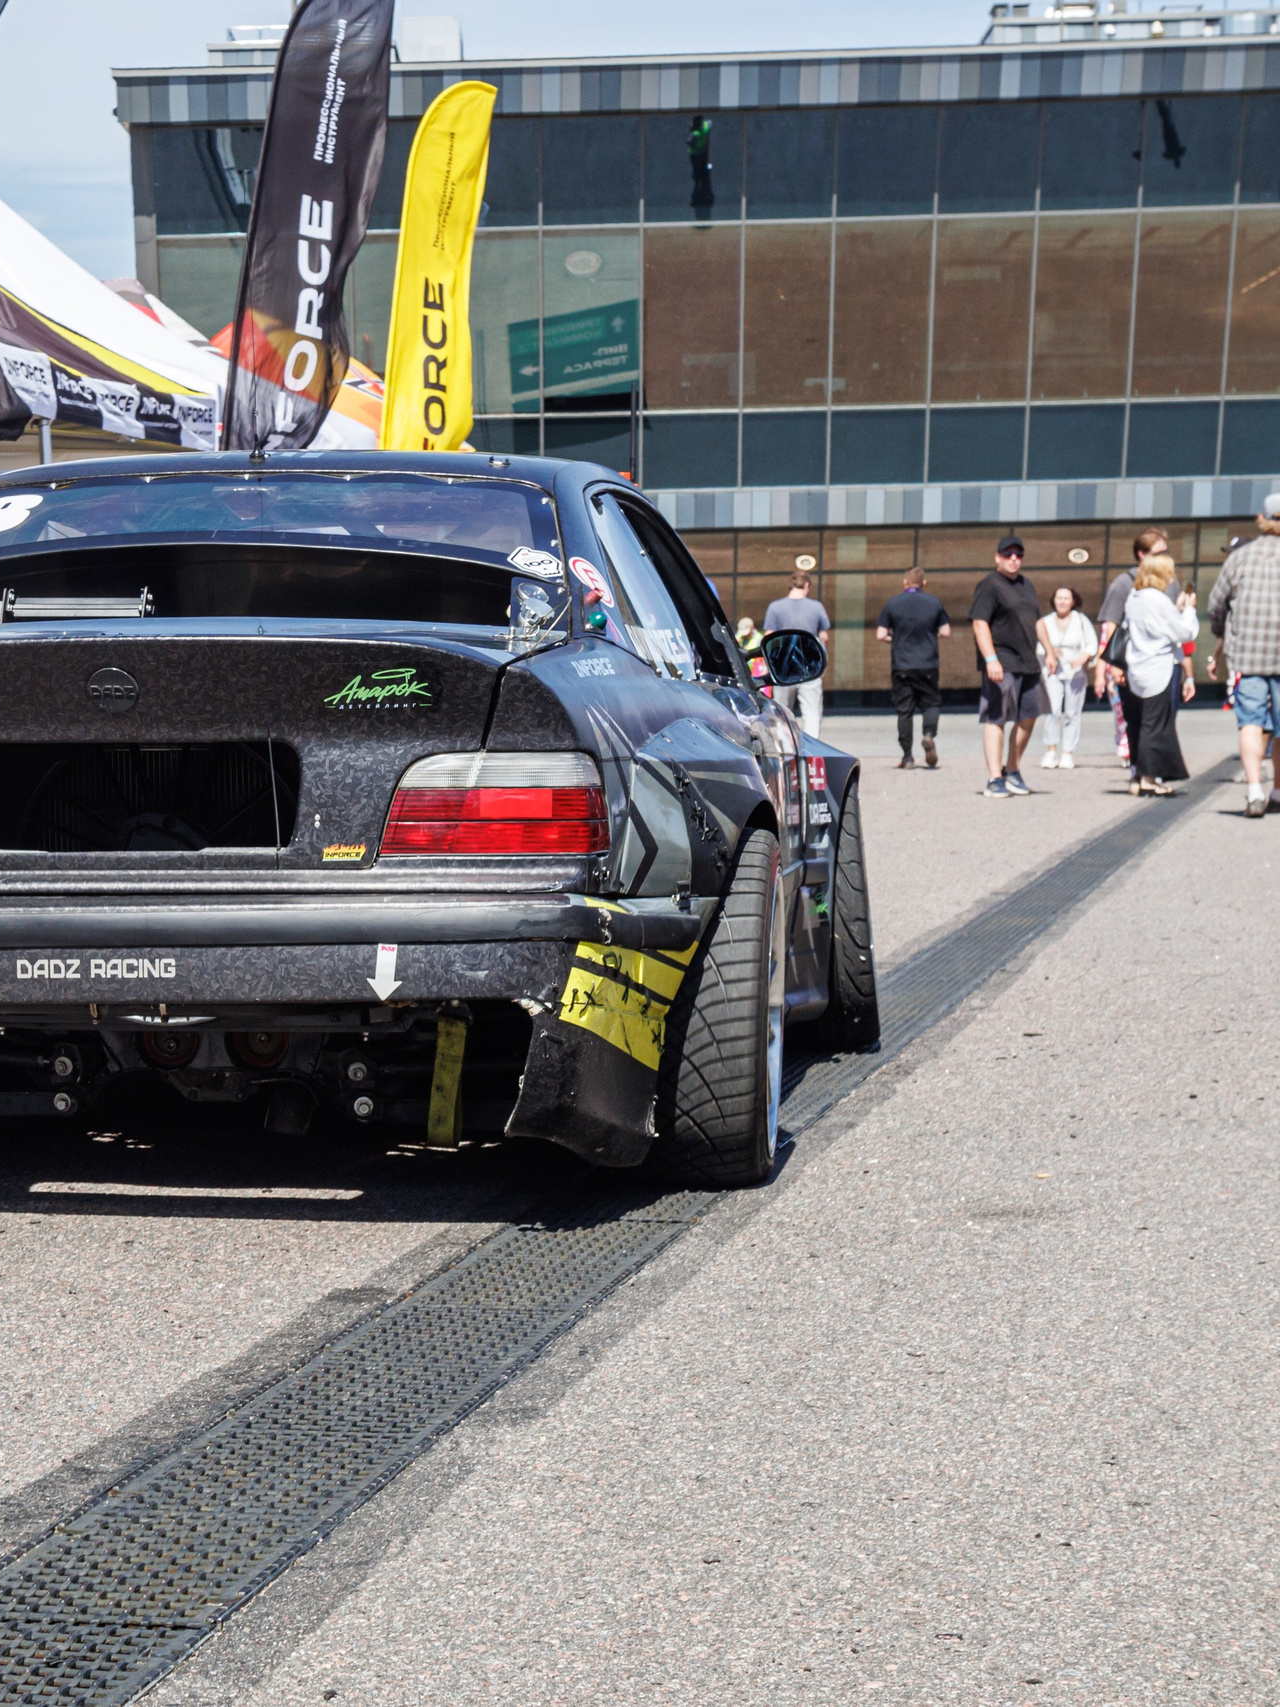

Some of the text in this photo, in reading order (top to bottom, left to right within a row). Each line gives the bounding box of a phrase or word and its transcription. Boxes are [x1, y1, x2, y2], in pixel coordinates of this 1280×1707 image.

[313, 18, 347, 161] ПРОФЕССИОНАЛЬНЫЙ
[324, 77, 347, 164] ИНСТРУМЕНТ
[263, 193, 334, 450] FORCE
[422, 277, 449, 450] ORCE
[523, 559, 553, 568] 100
[571, 657, 616, 678] INFORCE
[338, 702, 417, 710] ДЕТЕЙЛИНГ
[16, 958, 176, 979] DADZ RACING
